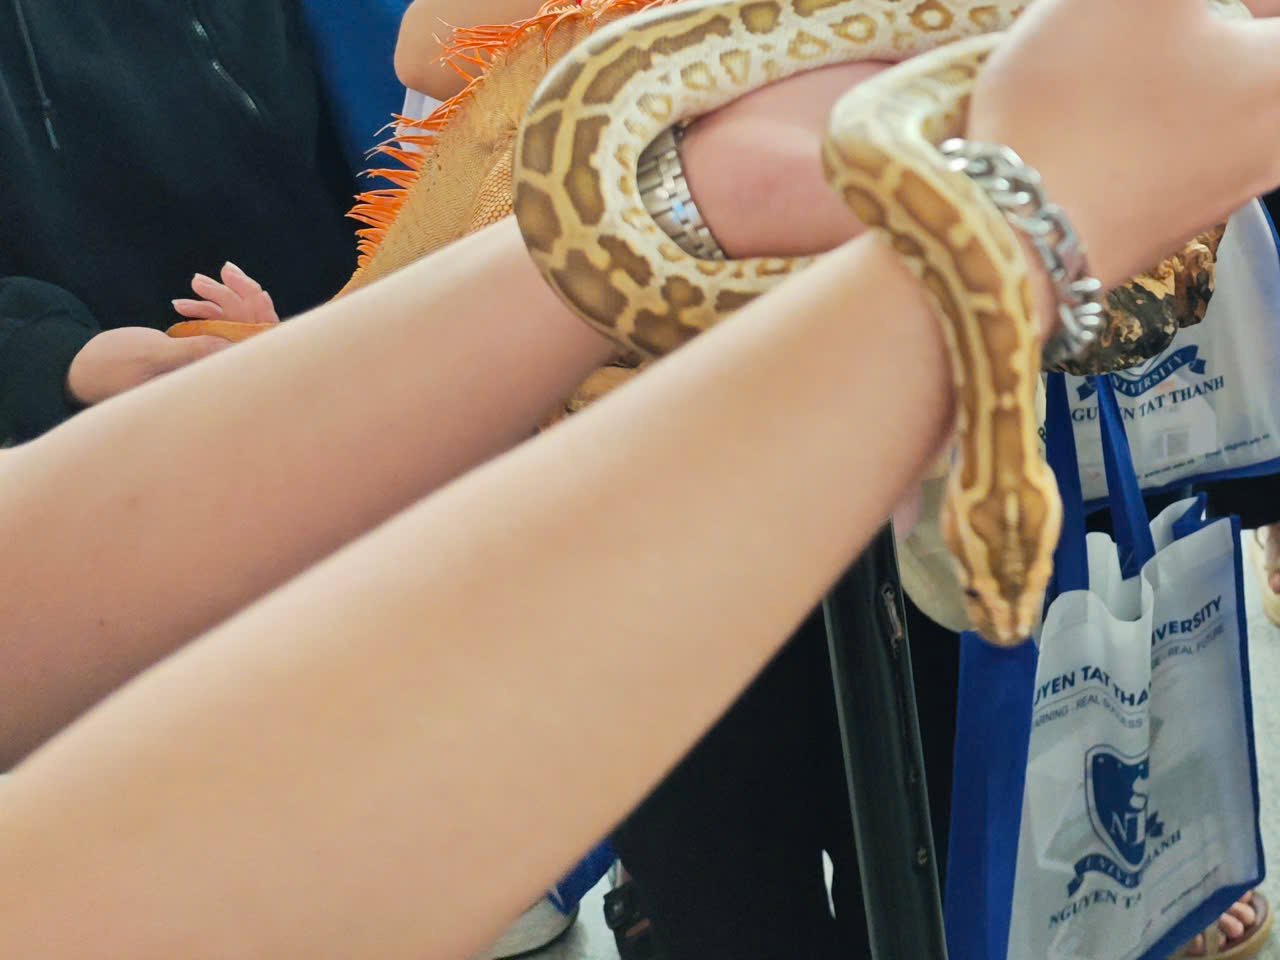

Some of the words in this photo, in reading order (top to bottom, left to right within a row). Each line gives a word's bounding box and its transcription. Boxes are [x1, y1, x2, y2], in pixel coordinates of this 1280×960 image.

[1138, 395, 1166, 417] TAT
[1168, 375, 1225, 404] THANH
[1081, 665, 1111, 687] TAT
